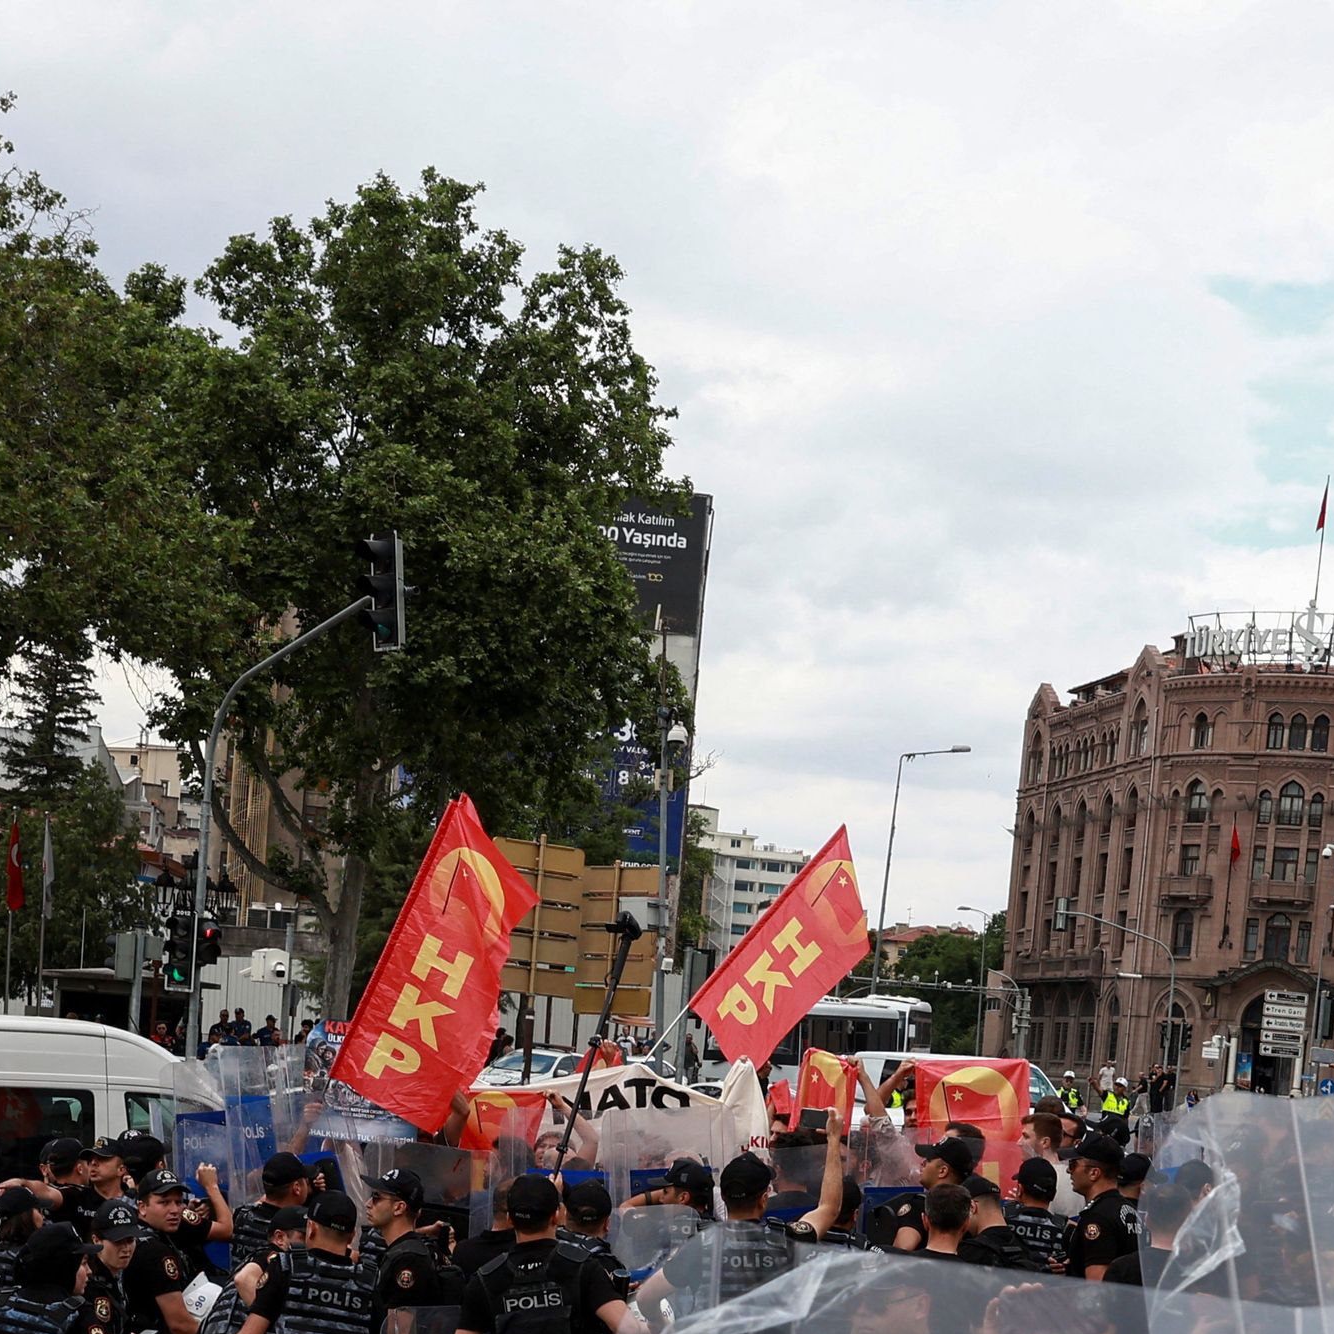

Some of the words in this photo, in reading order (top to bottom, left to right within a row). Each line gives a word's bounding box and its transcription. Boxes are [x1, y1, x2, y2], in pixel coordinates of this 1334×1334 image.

[638, 513, 675, 527] Katılım
[622, 527, 687, 548] Yaşında
[1184, 623, 1289, 658] TÜRKİYE
[716, 916, 822, 1026] HKP
[363, 933, 474, 1079] HKP
[1271, 1006, 1286, 1014] Tren
[552, 1077, 690, 1125] NATO
[307, 1288, 362, 1309] POLİS
[505, 1290, 561, 1312] POLİS
